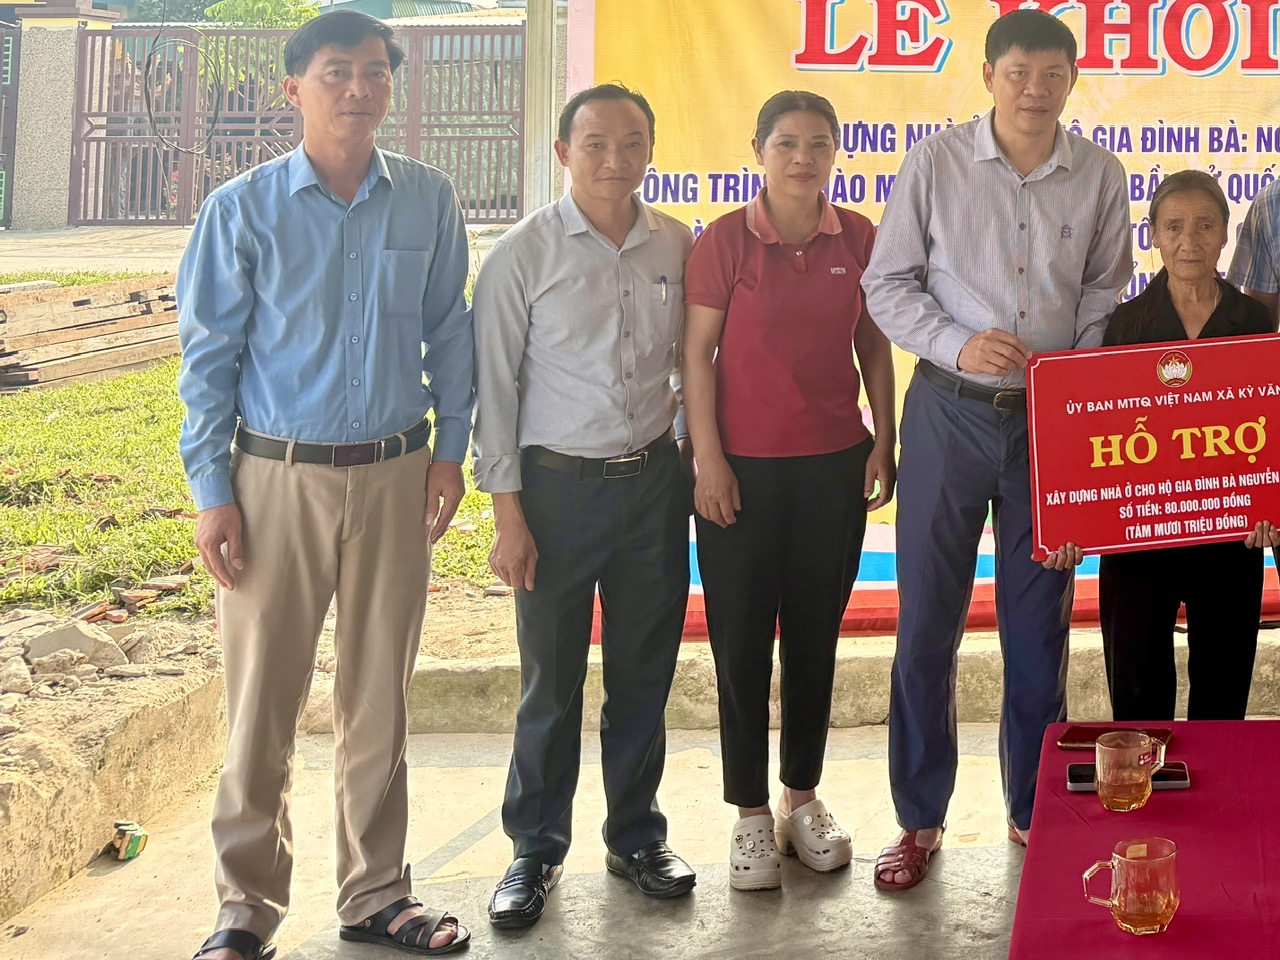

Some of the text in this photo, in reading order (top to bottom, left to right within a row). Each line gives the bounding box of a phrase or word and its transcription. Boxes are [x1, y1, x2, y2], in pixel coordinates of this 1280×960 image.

[838, 120, 897, 159] ỰNG
[1092, 124, 1133, 153] GIA
[1140, 119, 1200, 153] ĐÌNH
[1208, 119, 1248, 153] BÀ:
[637, 167, 699, 203] ÔNG
[708, 167, 767, 203] TRÌN
[1066, 400, 1082, 415] ỦY
[1087, 399, 1113, 412] BAN
[1117, 397, 1152, 410] MTTQ
[1155, 392, 1180, 408] VIỆT
[1184, 391, 1213, 403] NAM
[1216, 386, 1235, 400] XÃ
[1238, 385, 1255, 398] KỲ
[1089, 415, 1267, 468] HỖ TRỢ
[1046, 489, 1067, 506] XÂY
[1069, 488, 1098, 506] DỰNG
[1100, 484, 1123, 501] NHÀ
[1125, 481, 1132, 498] Ở
[1134, 483, 1156, 497] CHO
[1158, 479, 1172, 497] HỘ
[1175, 479, 1193, 493] GIA
[1194, 476, 1220, 491] ĐÌNH
[1222, 473, 1237, 488] BÀ
[1238, 467, 1280, 487] NGUYỄN
[1119, 501, 1134, 519] SỐ
[1164, 497, 1220, 515] 80.000.000
[1125, 522, 1152, 541] (TÁM
[1154, 520, 1182, 538] MƯƠI
[1183, 516, 1214, 535] TRIỆU
